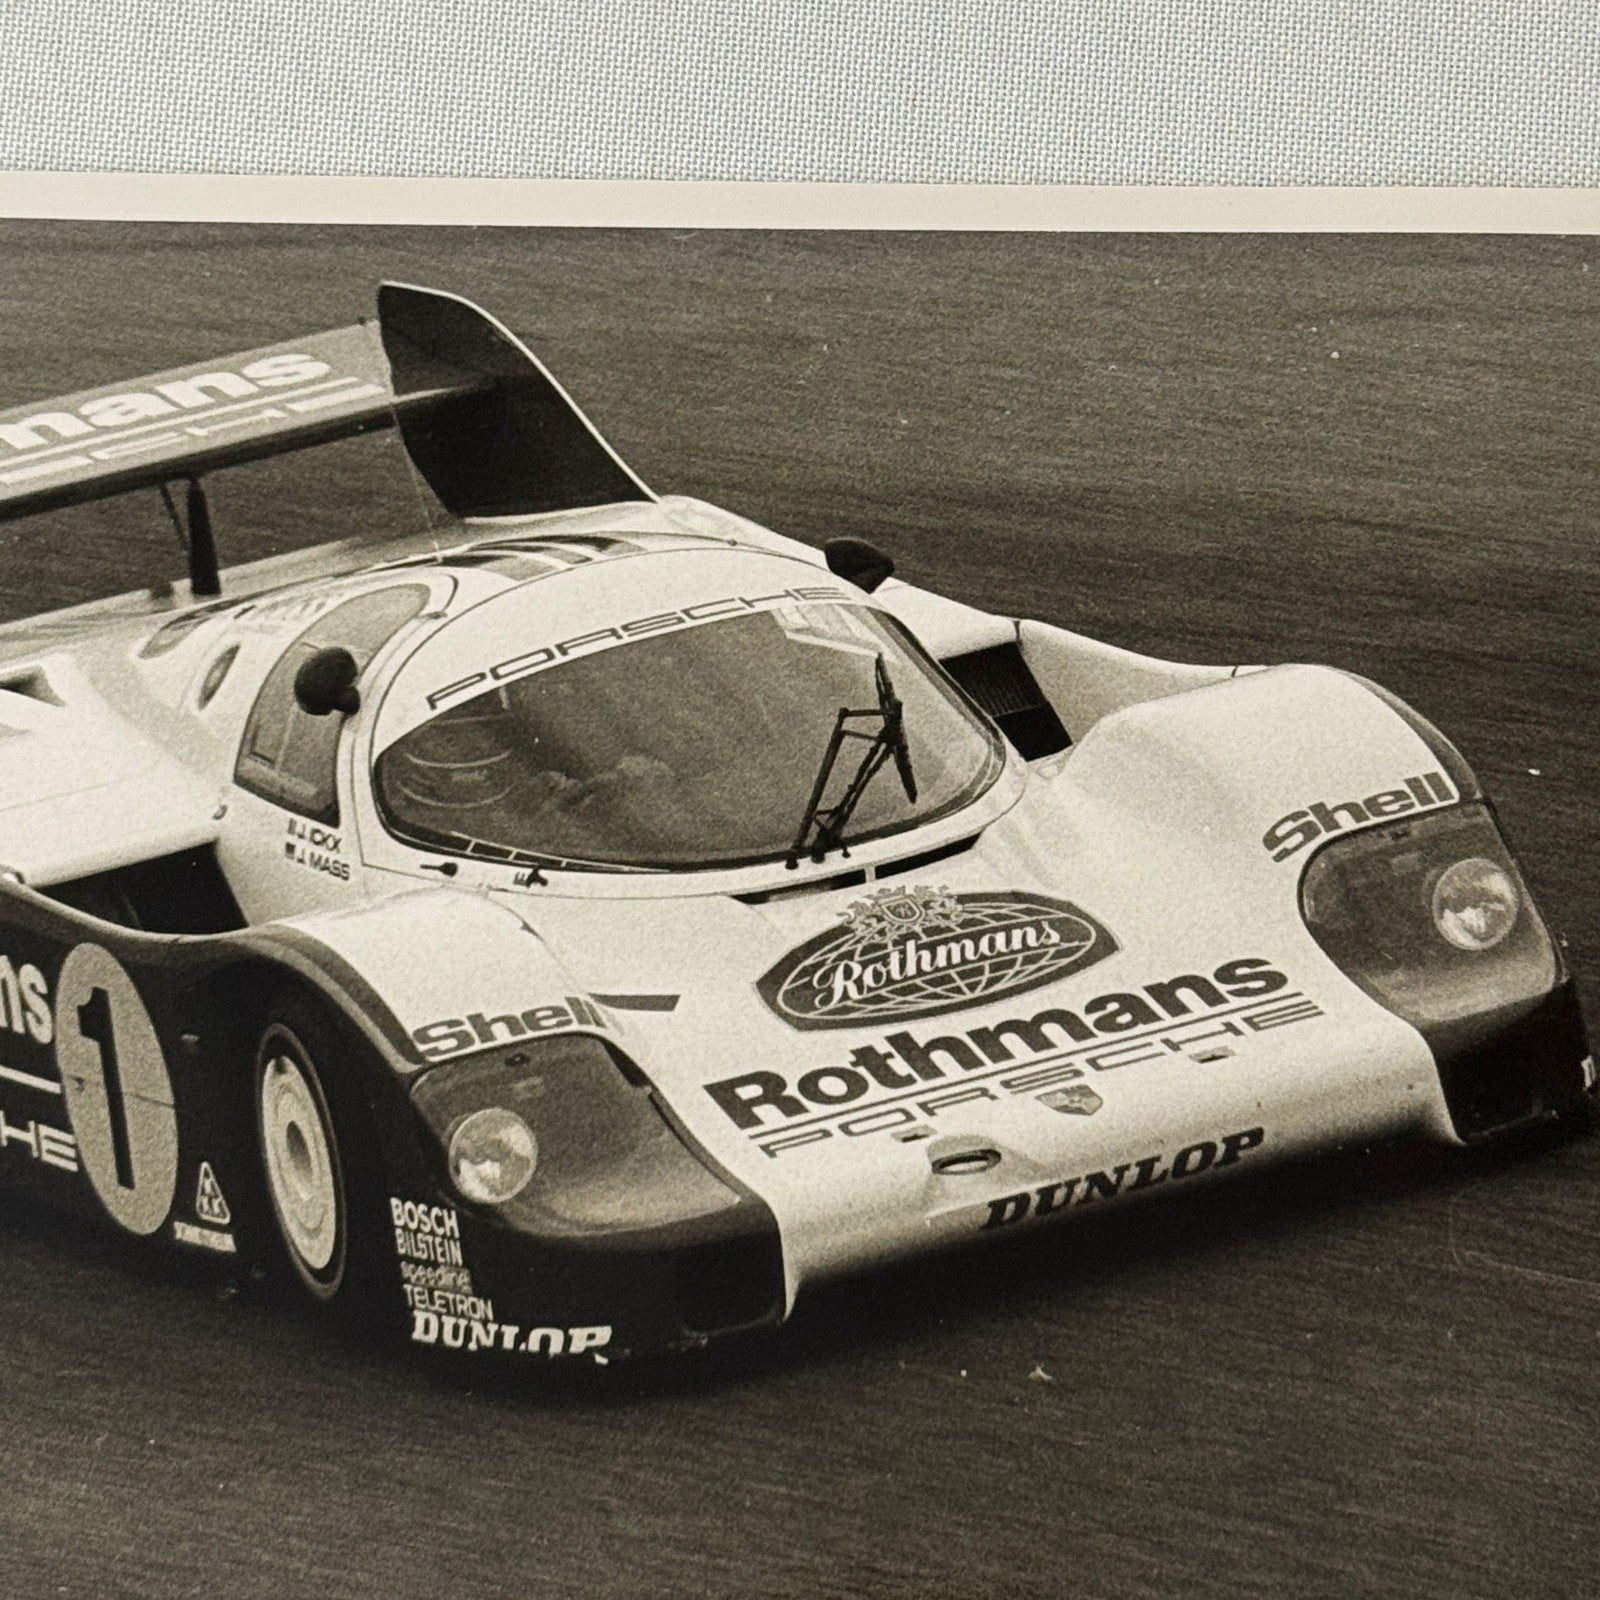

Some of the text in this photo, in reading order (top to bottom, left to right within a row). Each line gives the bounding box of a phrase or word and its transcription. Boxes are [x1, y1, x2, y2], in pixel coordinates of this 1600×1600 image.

[425, 587, 853, 711] PORSCHE
[1262, 771, 1456, 863] Shell
[812, 920, 1061, 1009] Rothmans
[412, 996, 607, 1058] Shell
[704, 957, 1288, 1131] Rothmans
[77, 986, 136, 1191] 1
[759, 996, 1326, 1159] PORSCHE
[390, 1197, 460, 1239] BOSCH
[979, 1126, 1266, 1230] DUNLOP
[395, 1228, 463, 1267] BILSTEIN
[403, 1284, 494, 1322] TELETRON
[411, 1309, 612, 1360] DUNLOP
